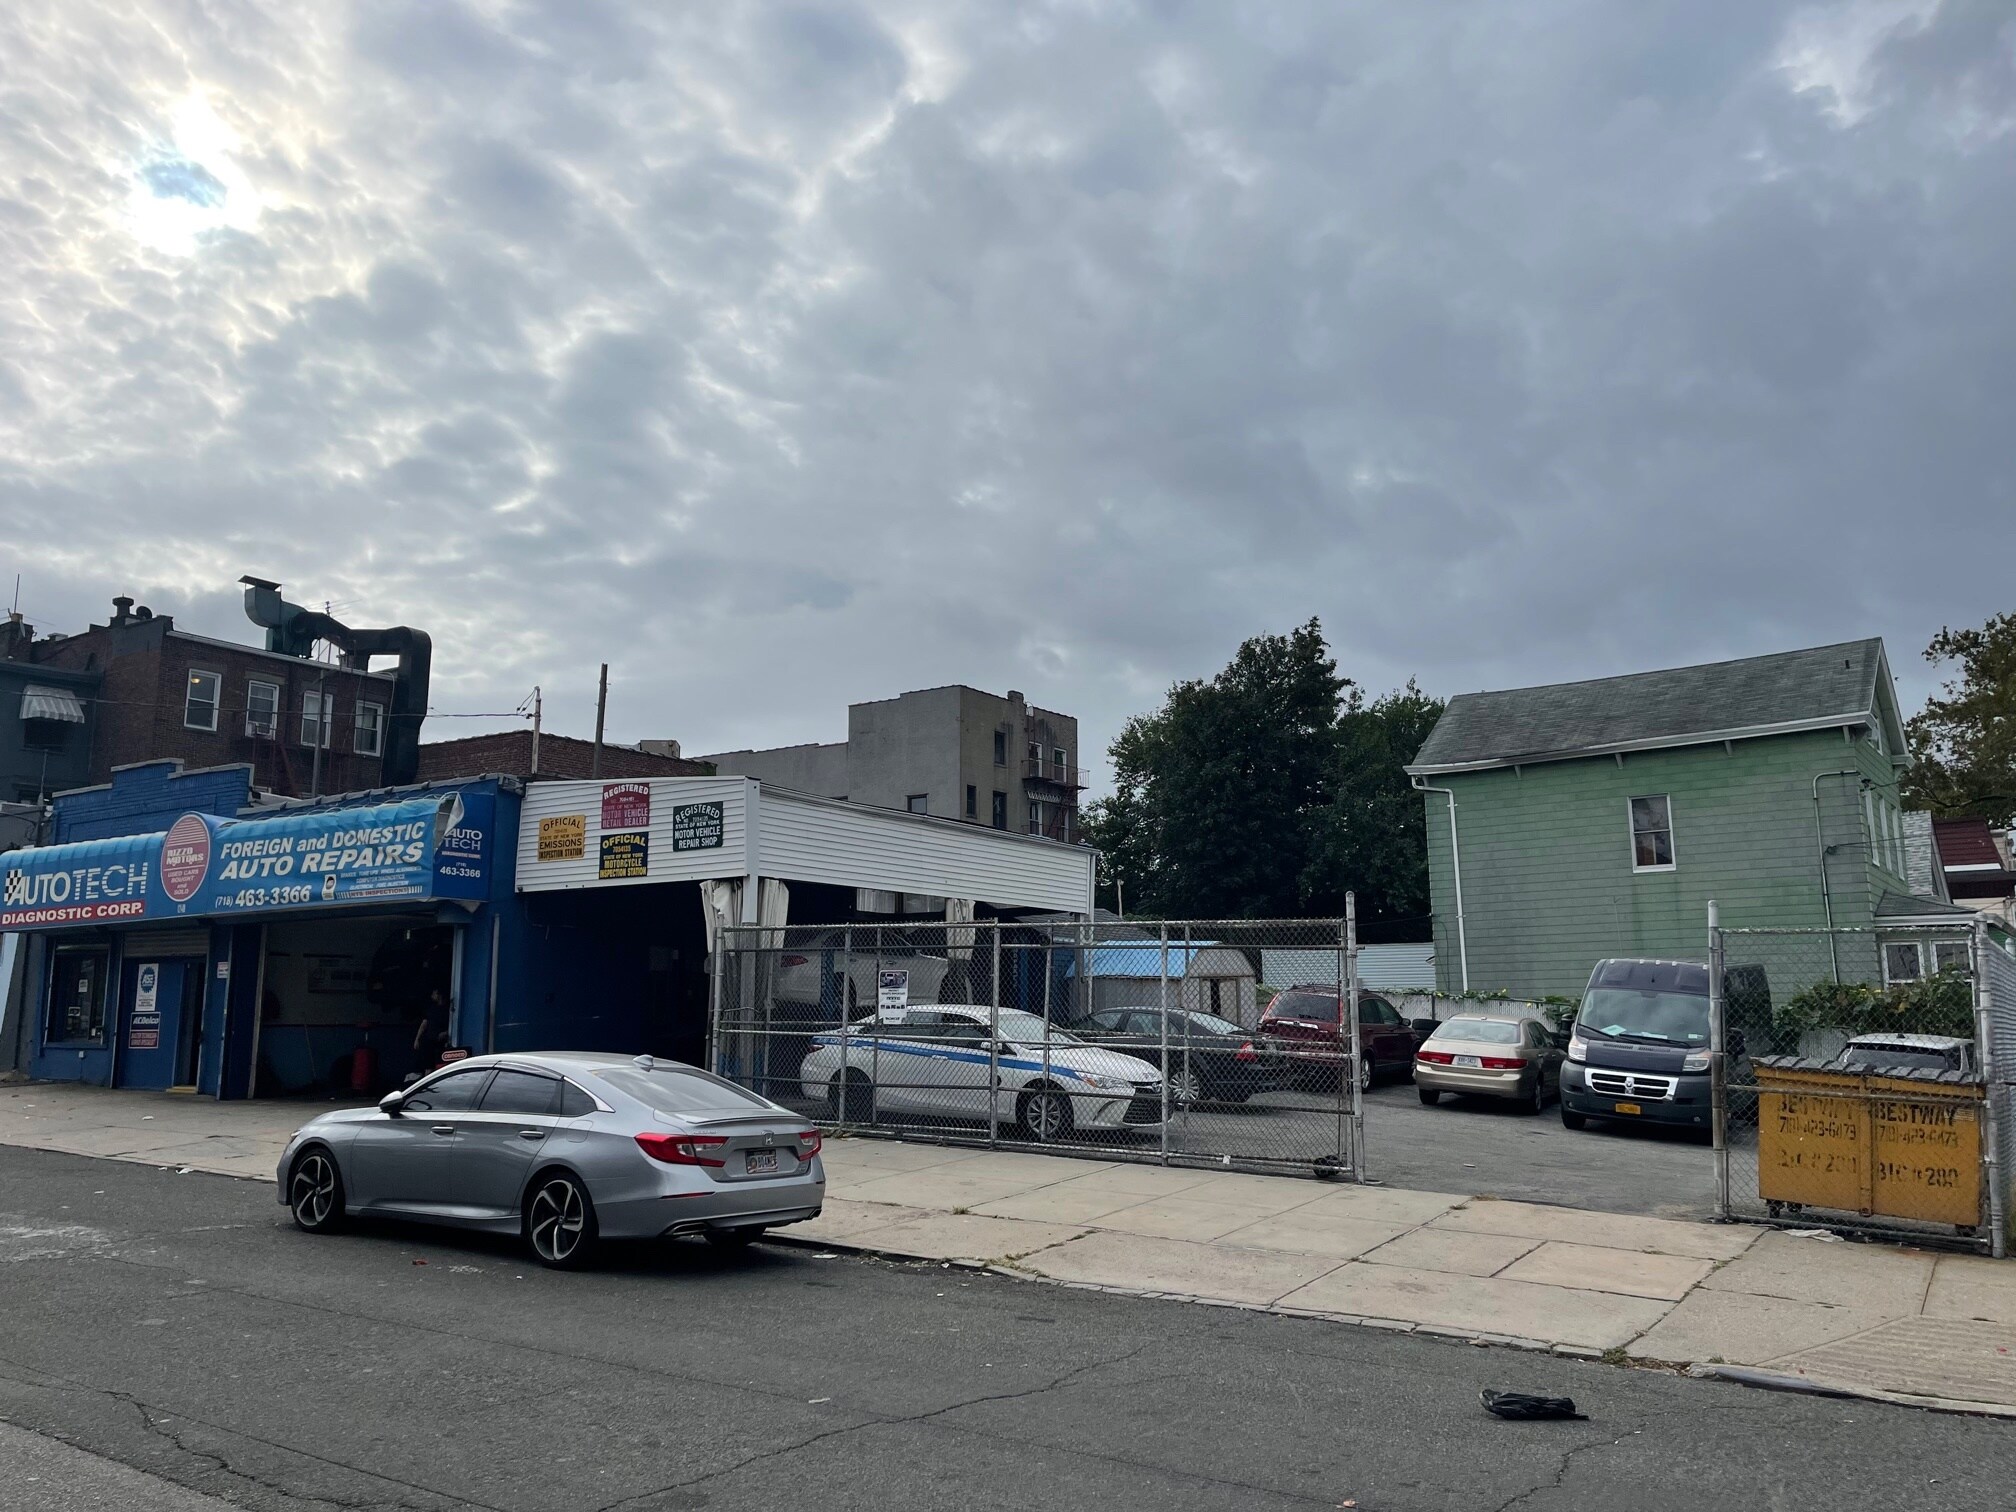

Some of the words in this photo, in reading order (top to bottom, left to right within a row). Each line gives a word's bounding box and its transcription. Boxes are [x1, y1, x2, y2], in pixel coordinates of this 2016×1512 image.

[604, 784, 648, 800] REGISTERED
[602, 810, 622, 819] MOTOR
[624, 808, 648, 818] VEHICLE
[675, 804, 720, 823] REGISTERED
[543, 818, 580, 831] OFFICIAL
[603, 818, 622, 828] RETAIL
[624, 816, 646, 826] DEALER
[446, 828, 482, 840] AUTO
[674, 829, 694, 839] MOTOR
[696, 826, 720, 837] VEHICLE
[220, 837, 294, 860] FOREIGN
[297, 833, 328, 852] and
[332, 822, 425, 848] DOMESTIC
[444, 838, 480, 850] TECH
[540, 838, 582, 850] EMISSIONS
[602, 834, 646, 848] OFFICIAL
[678, 839, 700, 848] REPAIR
[702, 836, 718, 846] SHOP
[168, 847, 193, 858] RIZZO
[540, 850, 563, 860] INSPECTION
[564, 848, 582, 856] STATION
[166, 853, 204, 866] MOTORS
[219, 855, 294, 880] AUTO
[300, 842, 424, 874] REPAIRS
[604, 858, 642, 868] MOTORCYCLE
[440, 866, 480, 878] 463-3366
[600, 868, 626, 878] INSPECTION
[628, 866, 647, 876] STATION
[215, 896, 234, 908] (718)
[235, 886, 312, 907] 463-3366
[2, 907, 92, 925] DIAGNOSTIC
[97, 902, 143, 916] CORP.
[133, 1016, 159, 1024] ACDelco
[1874, 1102, 1957, 1126] BESTWAY
